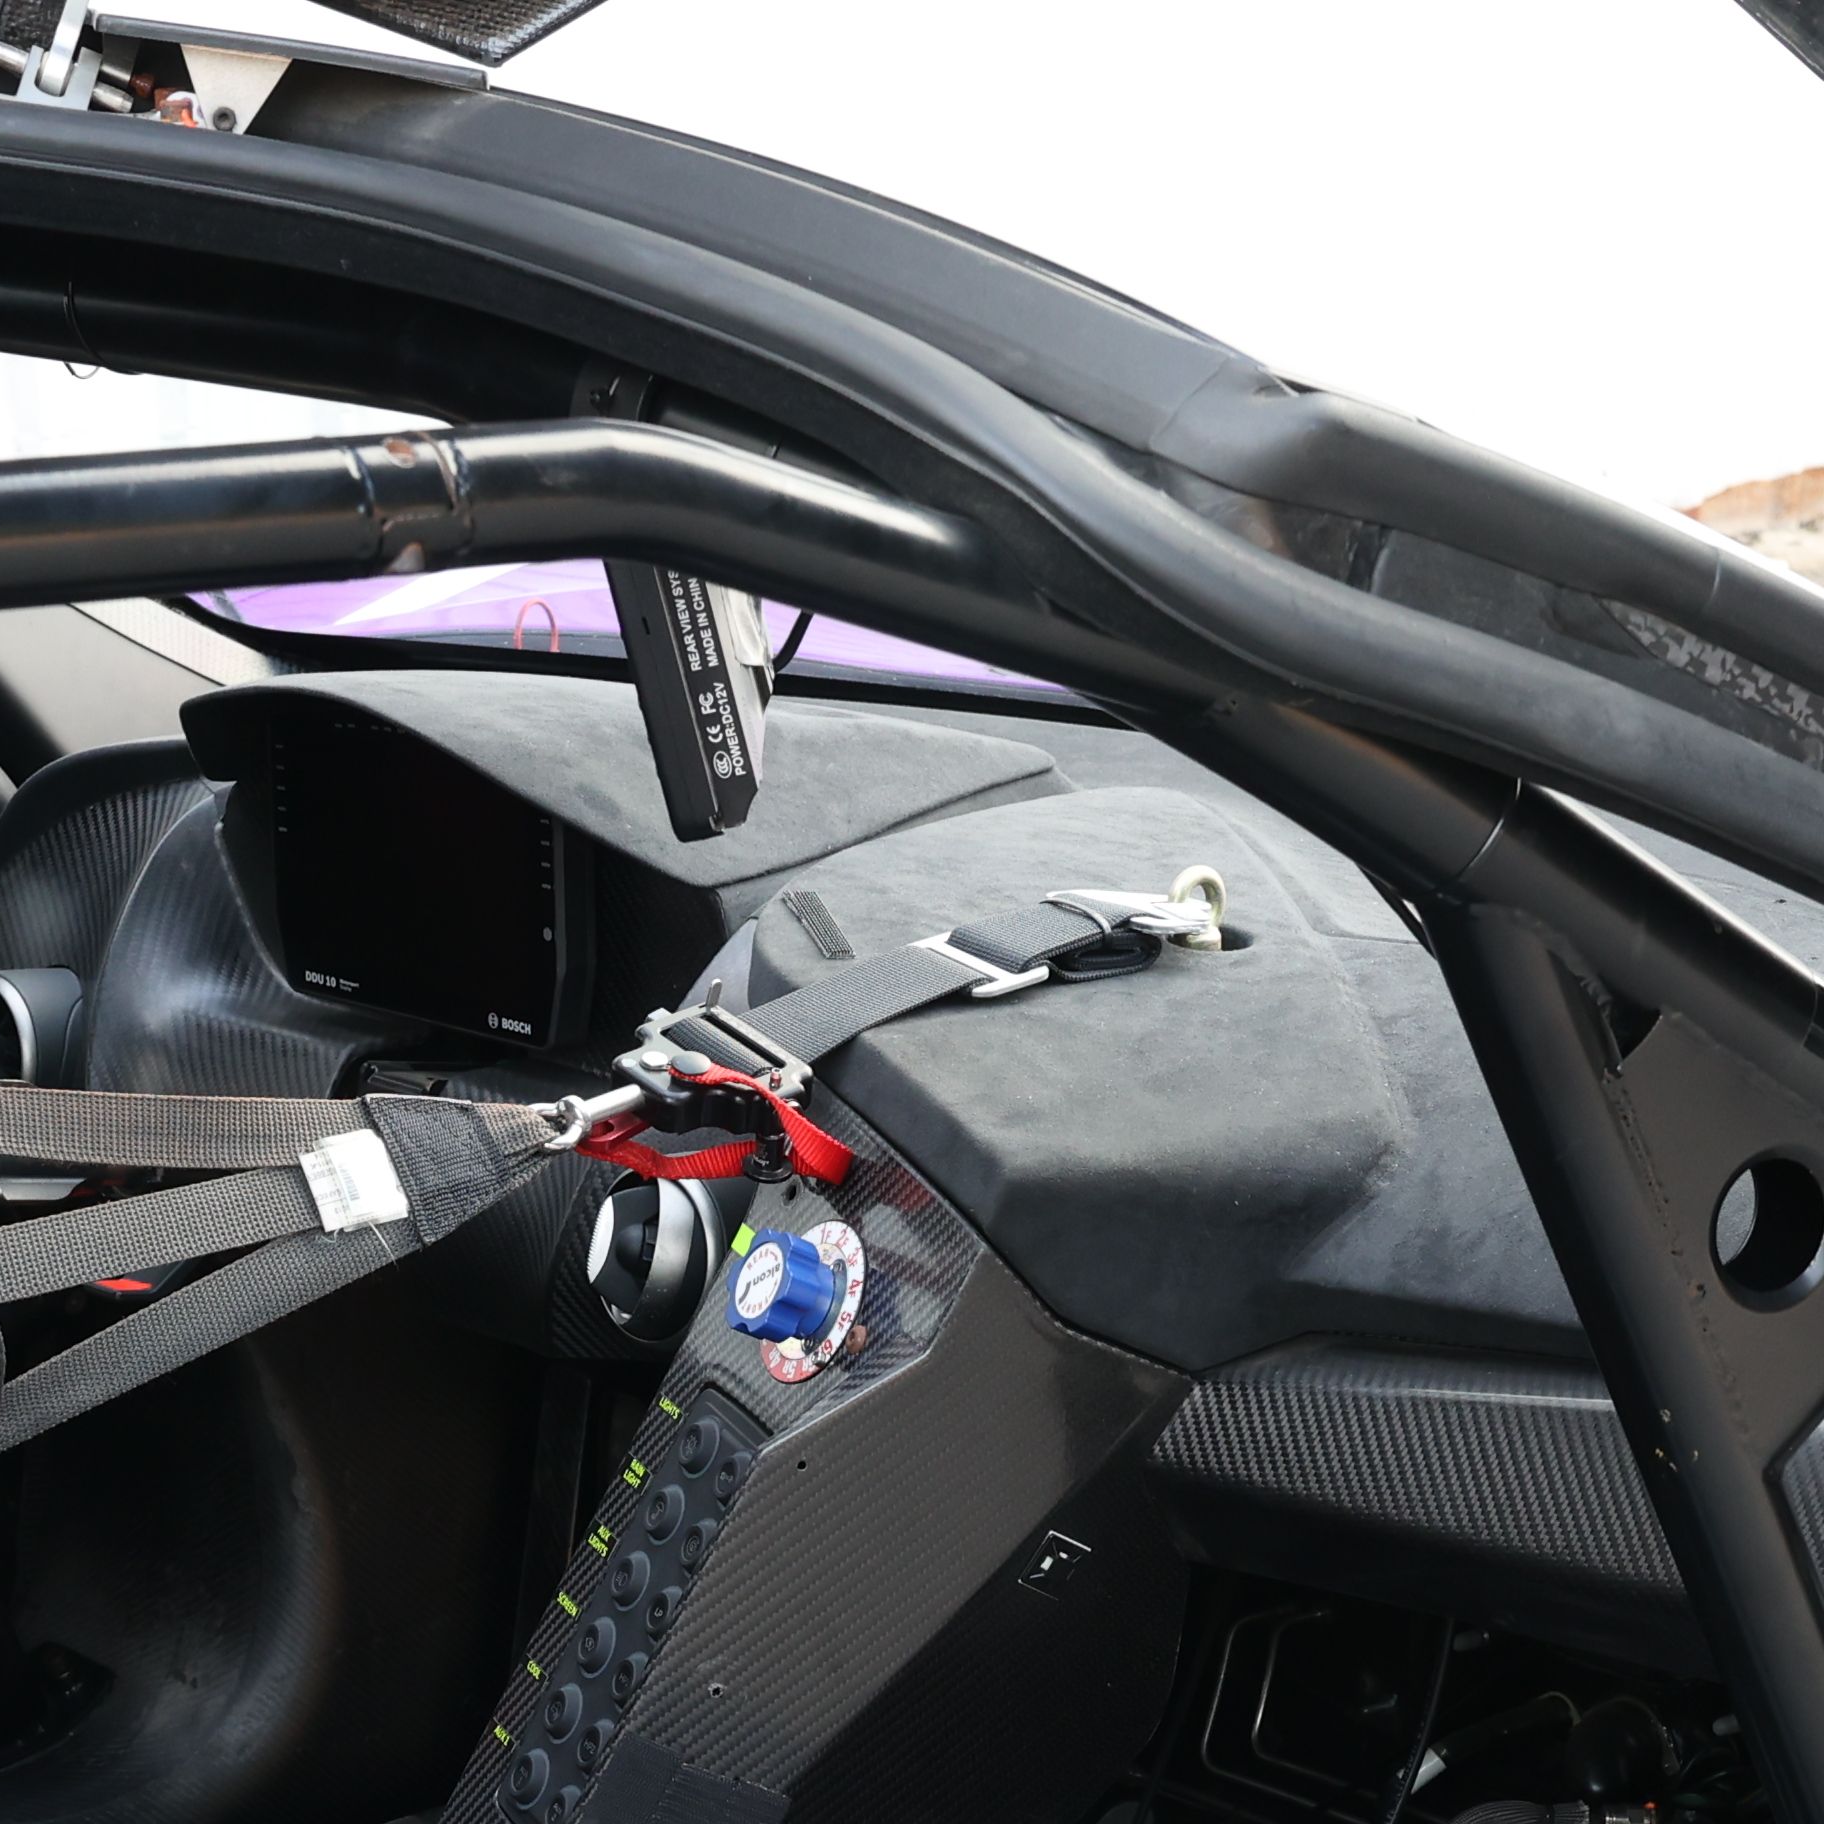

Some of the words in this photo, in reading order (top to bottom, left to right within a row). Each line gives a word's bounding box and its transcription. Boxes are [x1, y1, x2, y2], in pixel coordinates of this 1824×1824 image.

[675, 600, 693, 634] VIEW
[696, 612, 708, 628] IN
[685, 635, 702, 671] REAR
[700, 628, 719, 667] MADE
[713, 682, 747, 776] POWER:DC12V
[305, 970, 324, 985] DDU
[325, 975, 337, 988] 10
[501, 1017, 532, 1035] BOSCH
[659, 1396, 682, 1420] LIGHTS
[623, 1469, 641, 1488] LIGHT
[631, 1458, 646, 1477] RAIN
[597, 1524, 612, 1541] AUX
[588, 1533, 609, 1558] LIGHTS
[557, 1591, 579, 1617] SCREEN
[527, 1660, 541, 1680] COOL
